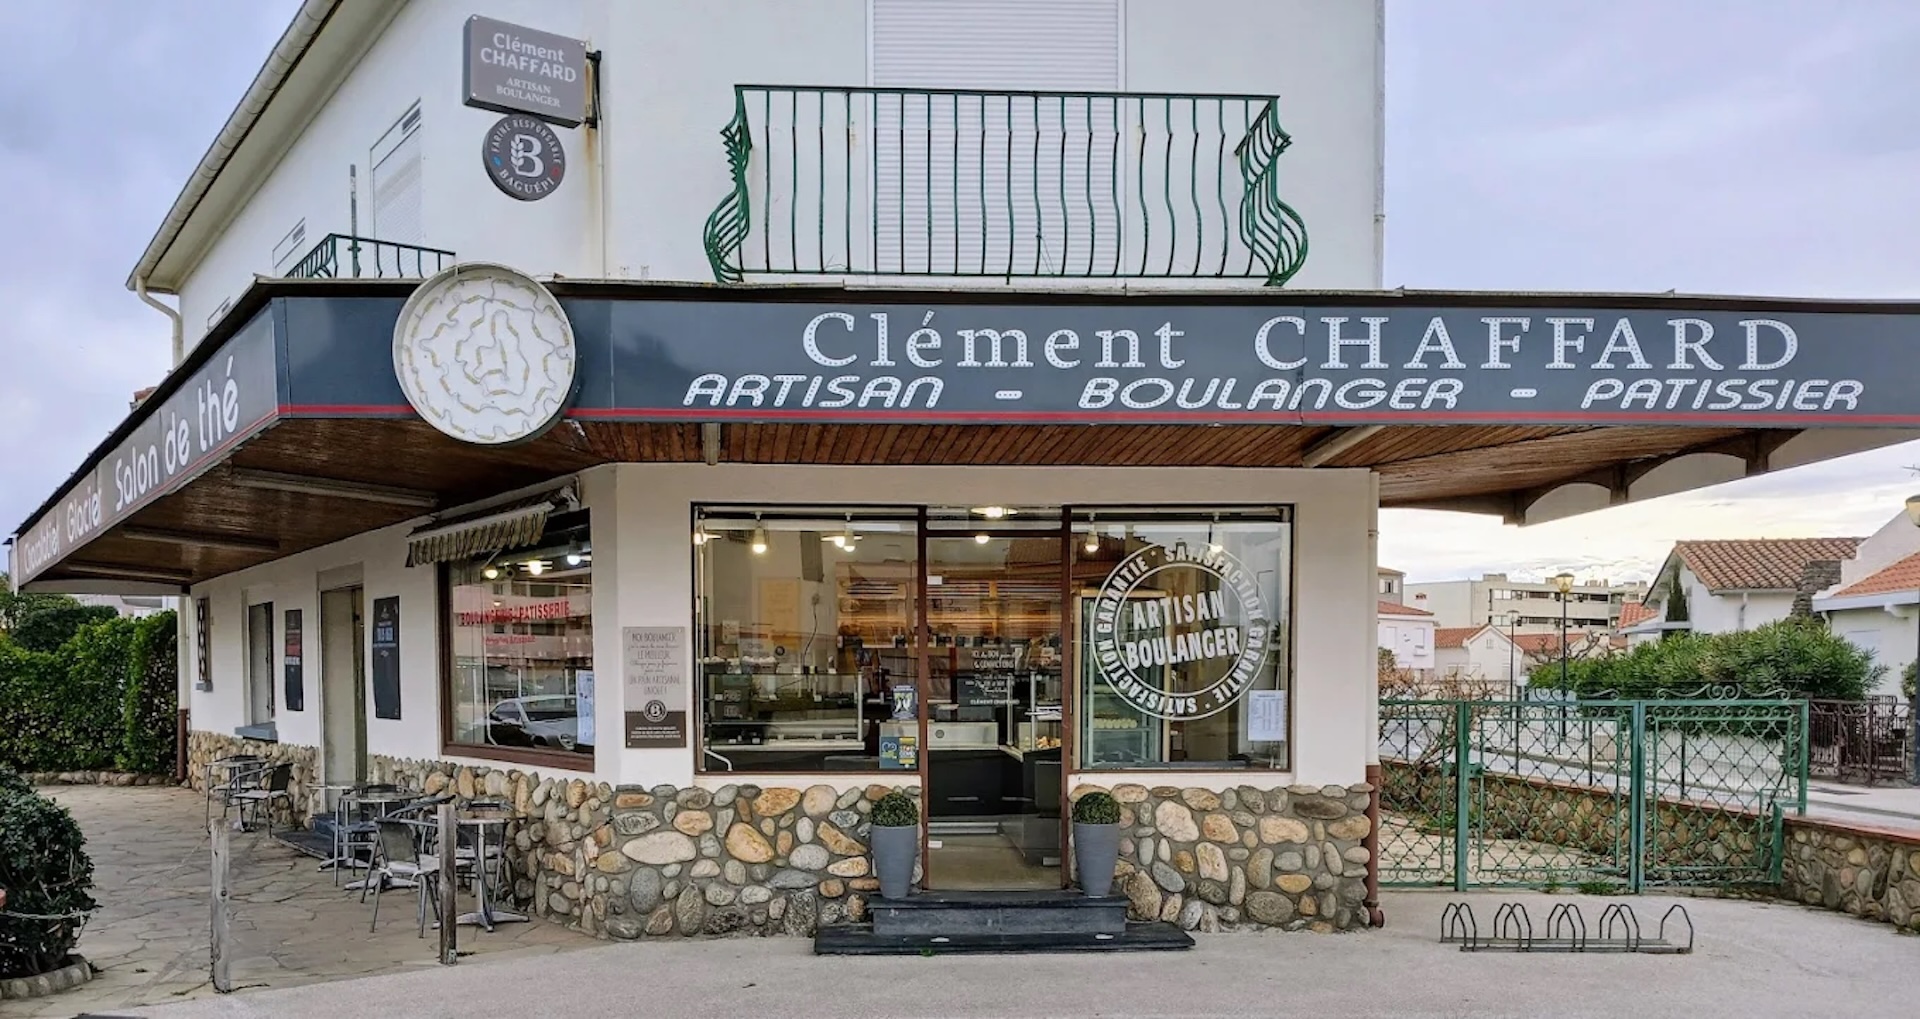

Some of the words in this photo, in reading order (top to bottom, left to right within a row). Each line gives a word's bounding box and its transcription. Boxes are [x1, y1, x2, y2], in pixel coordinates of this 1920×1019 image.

[480, 47, 576, 83] CHAFFARD
[493, 32, 564, 63] Clément
[496, 84, 561, 108] BOULANGER
[506, 77, 551, 93] ARTISAN
[491, 121, 512, 153] FARINE
[512, 119, 562, 164] RESPONSABLE
[499, 168, 555, 194] BAGUÉPI
[801, 309, 1186, 370] Clément
[1253, 314, 1800, 372] CHAFFARD
[682, 373, 945, 408] ARTISAN
[1078, 377, 1465, 411] BOULANGER
[1581, 377, 1865, 411] PATISSIER
[66, 486, 102, 544] Glacier
[114, 444, 160, 512] Salon
[164, 412, 190, 475] de
[198, 355, 239, 452] thé
[1096, 556, 1150, 634] GARANTIE
[1164, 545, 1264, 621] SATISFACTION
[519, 601, 570, 621] PATISSERIE
[1132, 590, 1225, 631] ARTISAN
[1125, 627, 1240, 671] BOULANGER
[1212, 626, 1265, 703] GARANTIE
[1097, 638, 1198, 714] SATISFACTION
